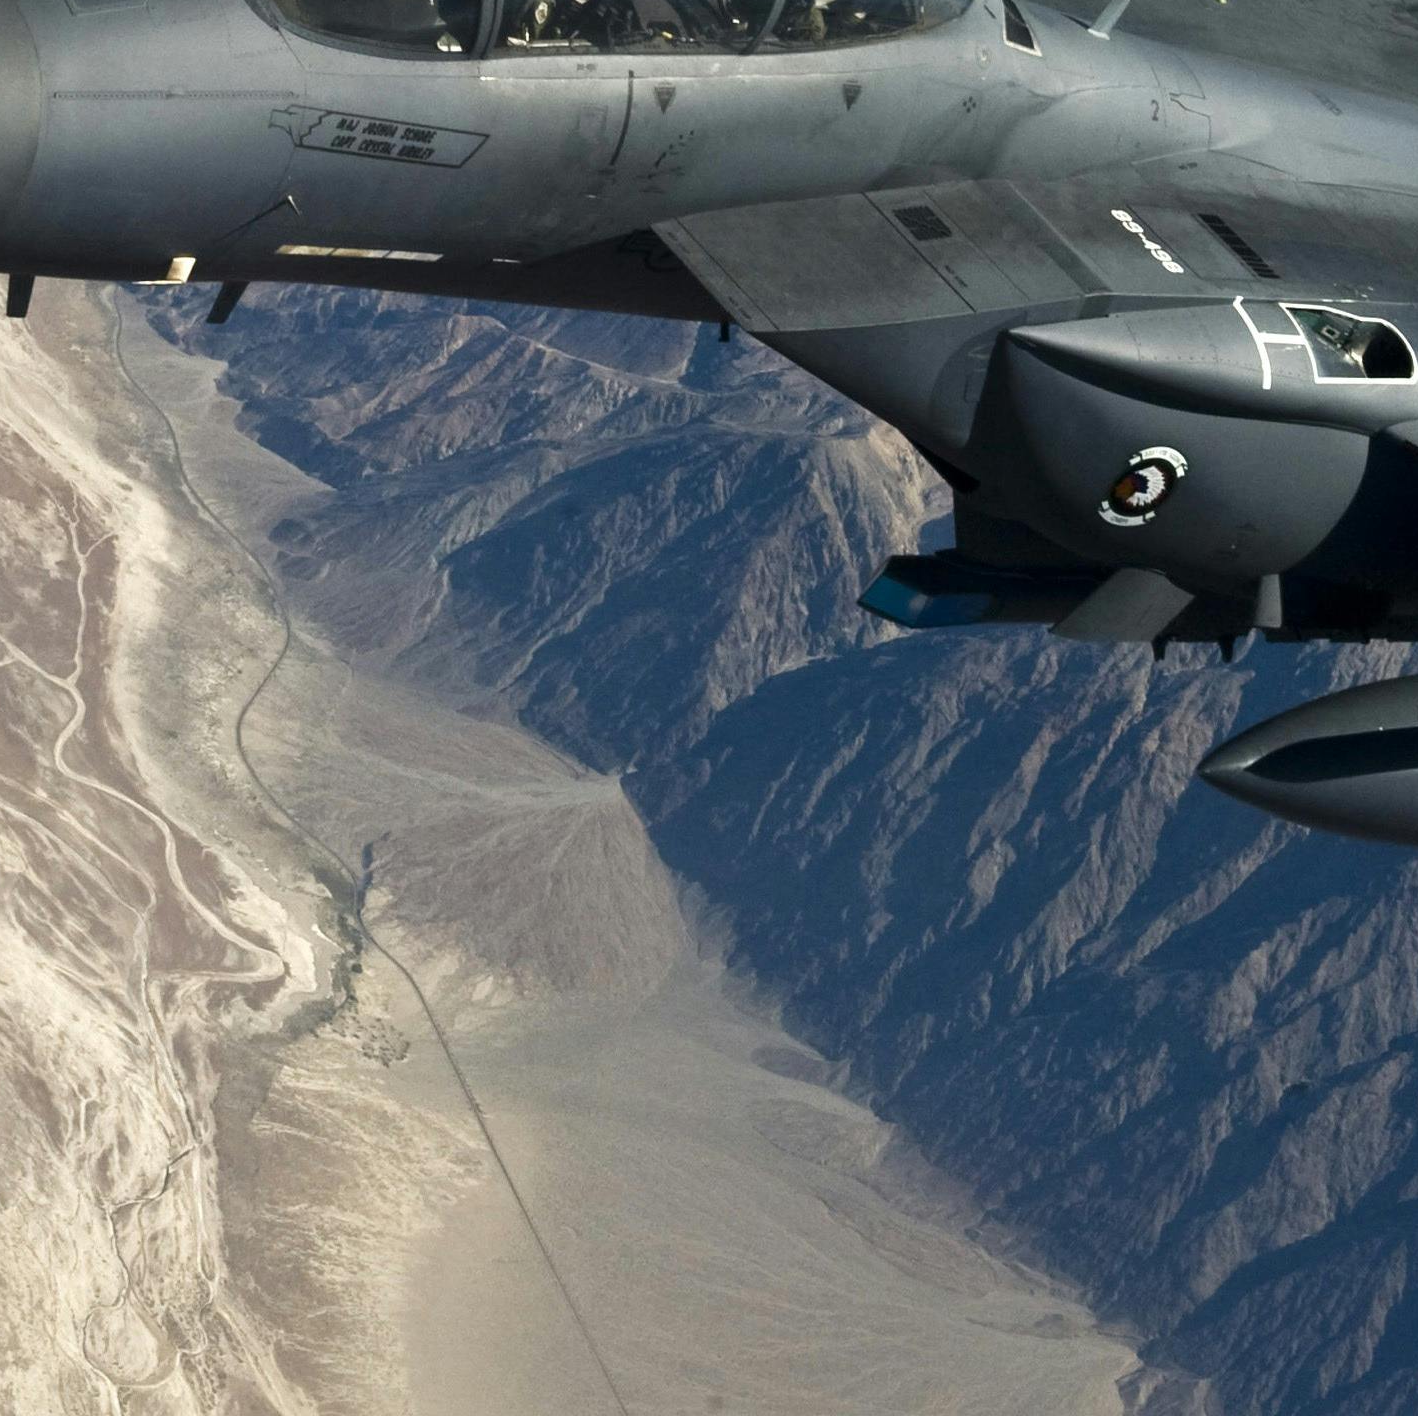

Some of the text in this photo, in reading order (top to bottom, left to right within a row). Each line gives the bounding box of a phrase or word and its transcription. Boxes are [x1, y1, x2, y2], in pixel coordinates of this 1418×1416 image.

[336, 118, 360, 132] MAJ
[331, 135, 357, 149] CAPT
[1110, 209, 1184, 273] 89-498
